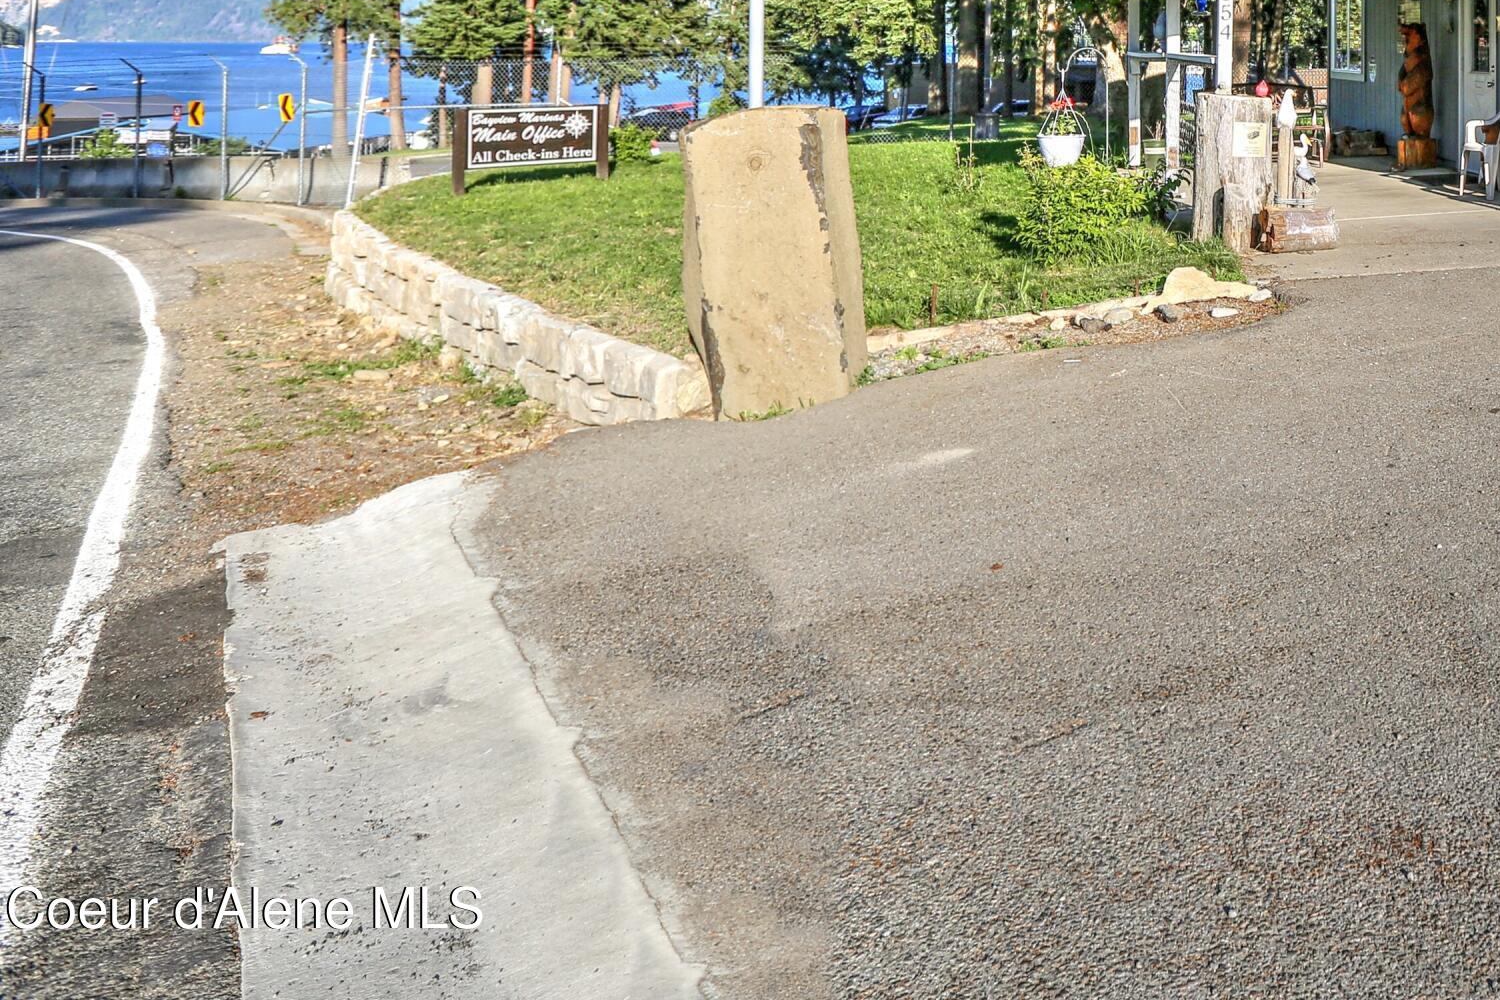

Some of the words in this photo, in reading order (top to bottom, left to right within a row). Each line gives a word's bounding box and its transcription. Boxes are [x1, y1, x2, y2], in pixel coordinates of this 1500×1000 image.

[472, 113, 517, 126] Bayview
[518, 112, 565, 122] Marinas
[471, 126, 518, 143] Main
[521, 124, 566, 145] Office
[472, 150, 492, 163] All
[495, 148, 560, 161] Check-ins
[562, 146, 592, 159] Here
